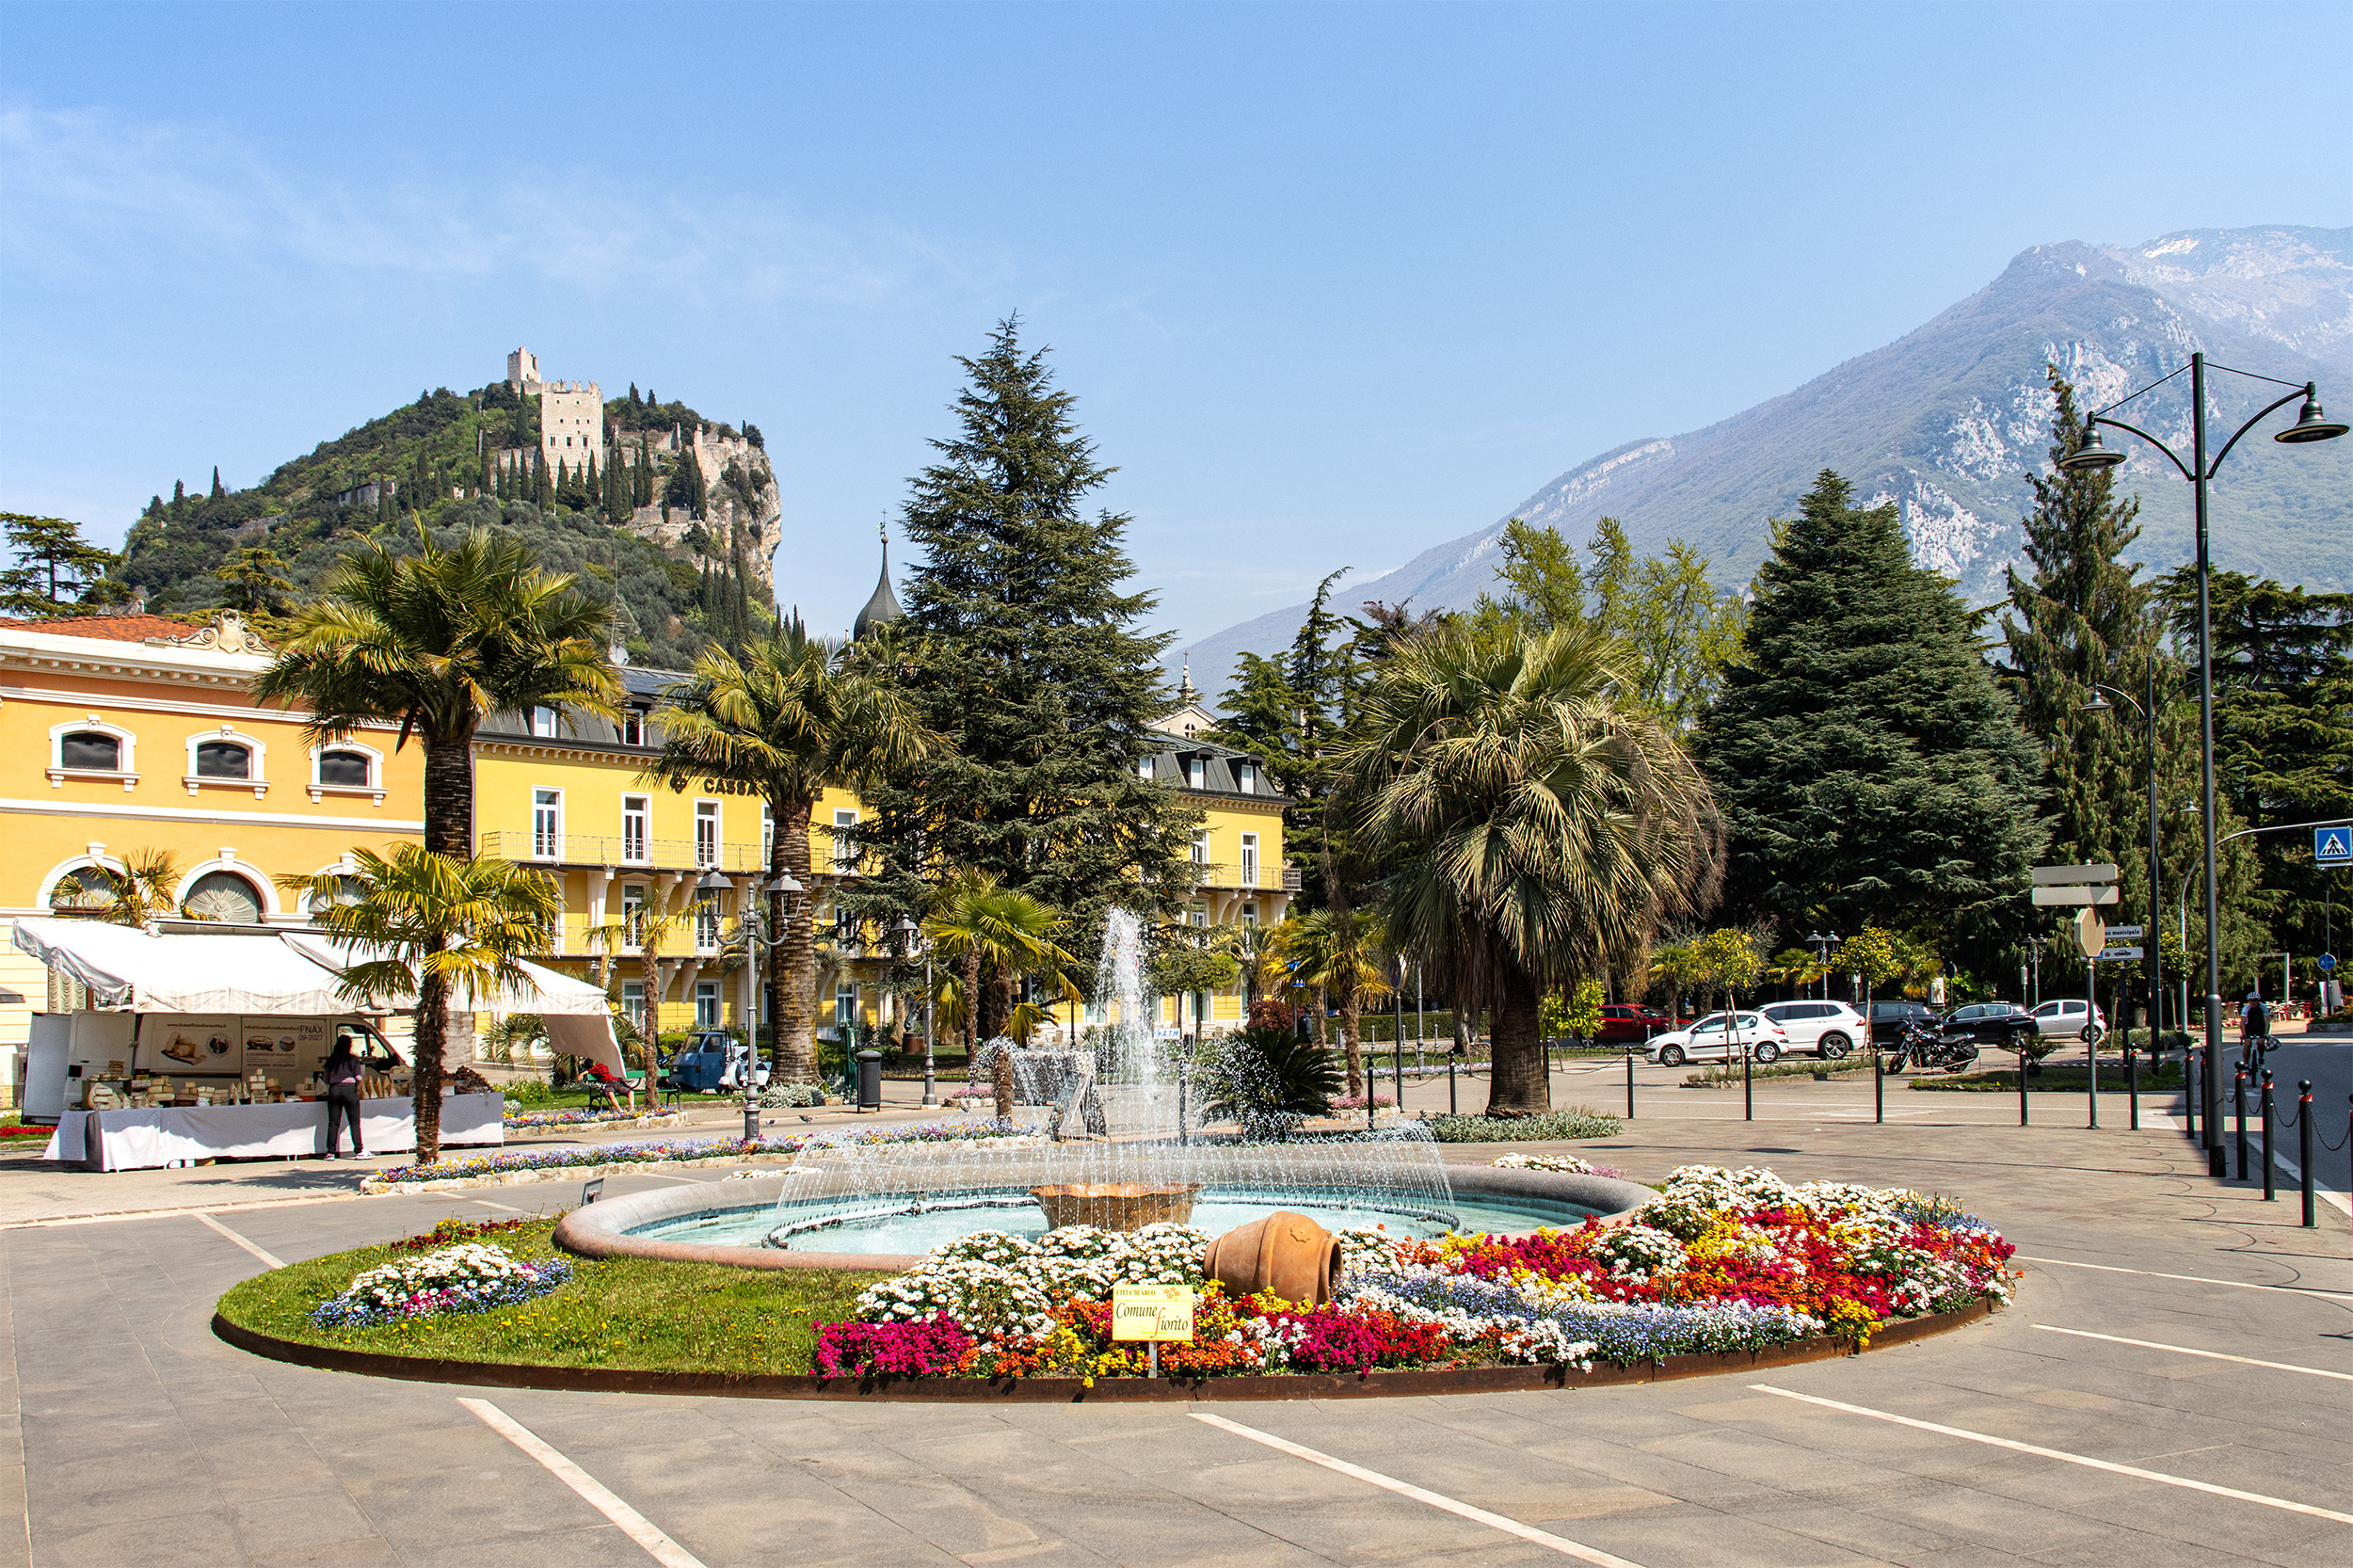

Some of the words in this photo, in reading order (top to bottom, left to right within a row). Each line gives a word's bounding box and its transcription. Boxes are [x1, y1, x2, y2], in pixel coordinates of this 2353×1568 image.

[299, 1025, 324, 1033] FNAX
[1116, 1303, 1157, 1319] Comune
[1149, 1307, 1189, 1338] fiorito
